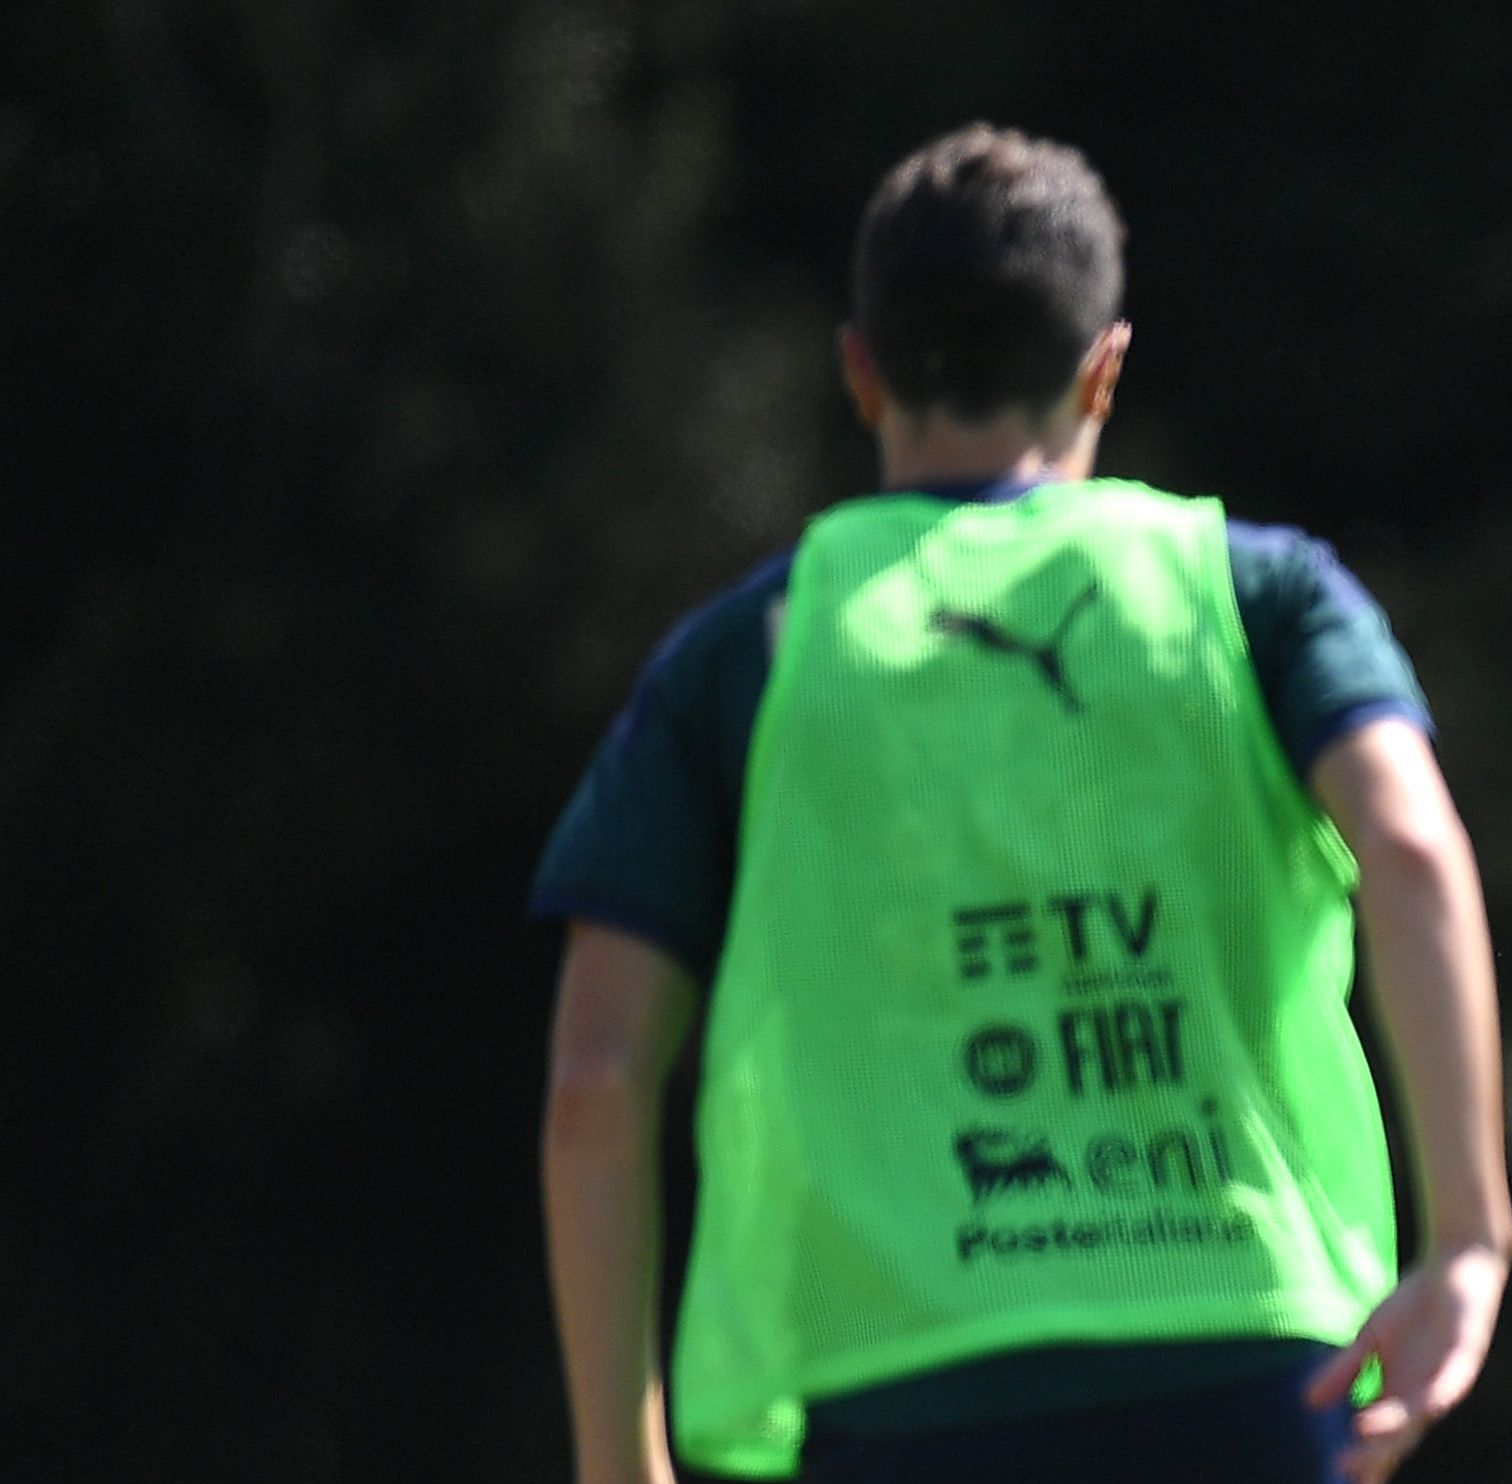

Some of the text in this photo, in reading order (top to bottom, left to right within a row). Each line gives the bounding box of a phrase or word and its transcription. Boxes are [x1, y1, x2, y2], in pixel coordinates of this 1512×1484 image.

[1047, 884, 1160, 962] TV
[1057, 998, 1186, 1096] FIAT
[1085, 1097, 1232, 1193] eni
